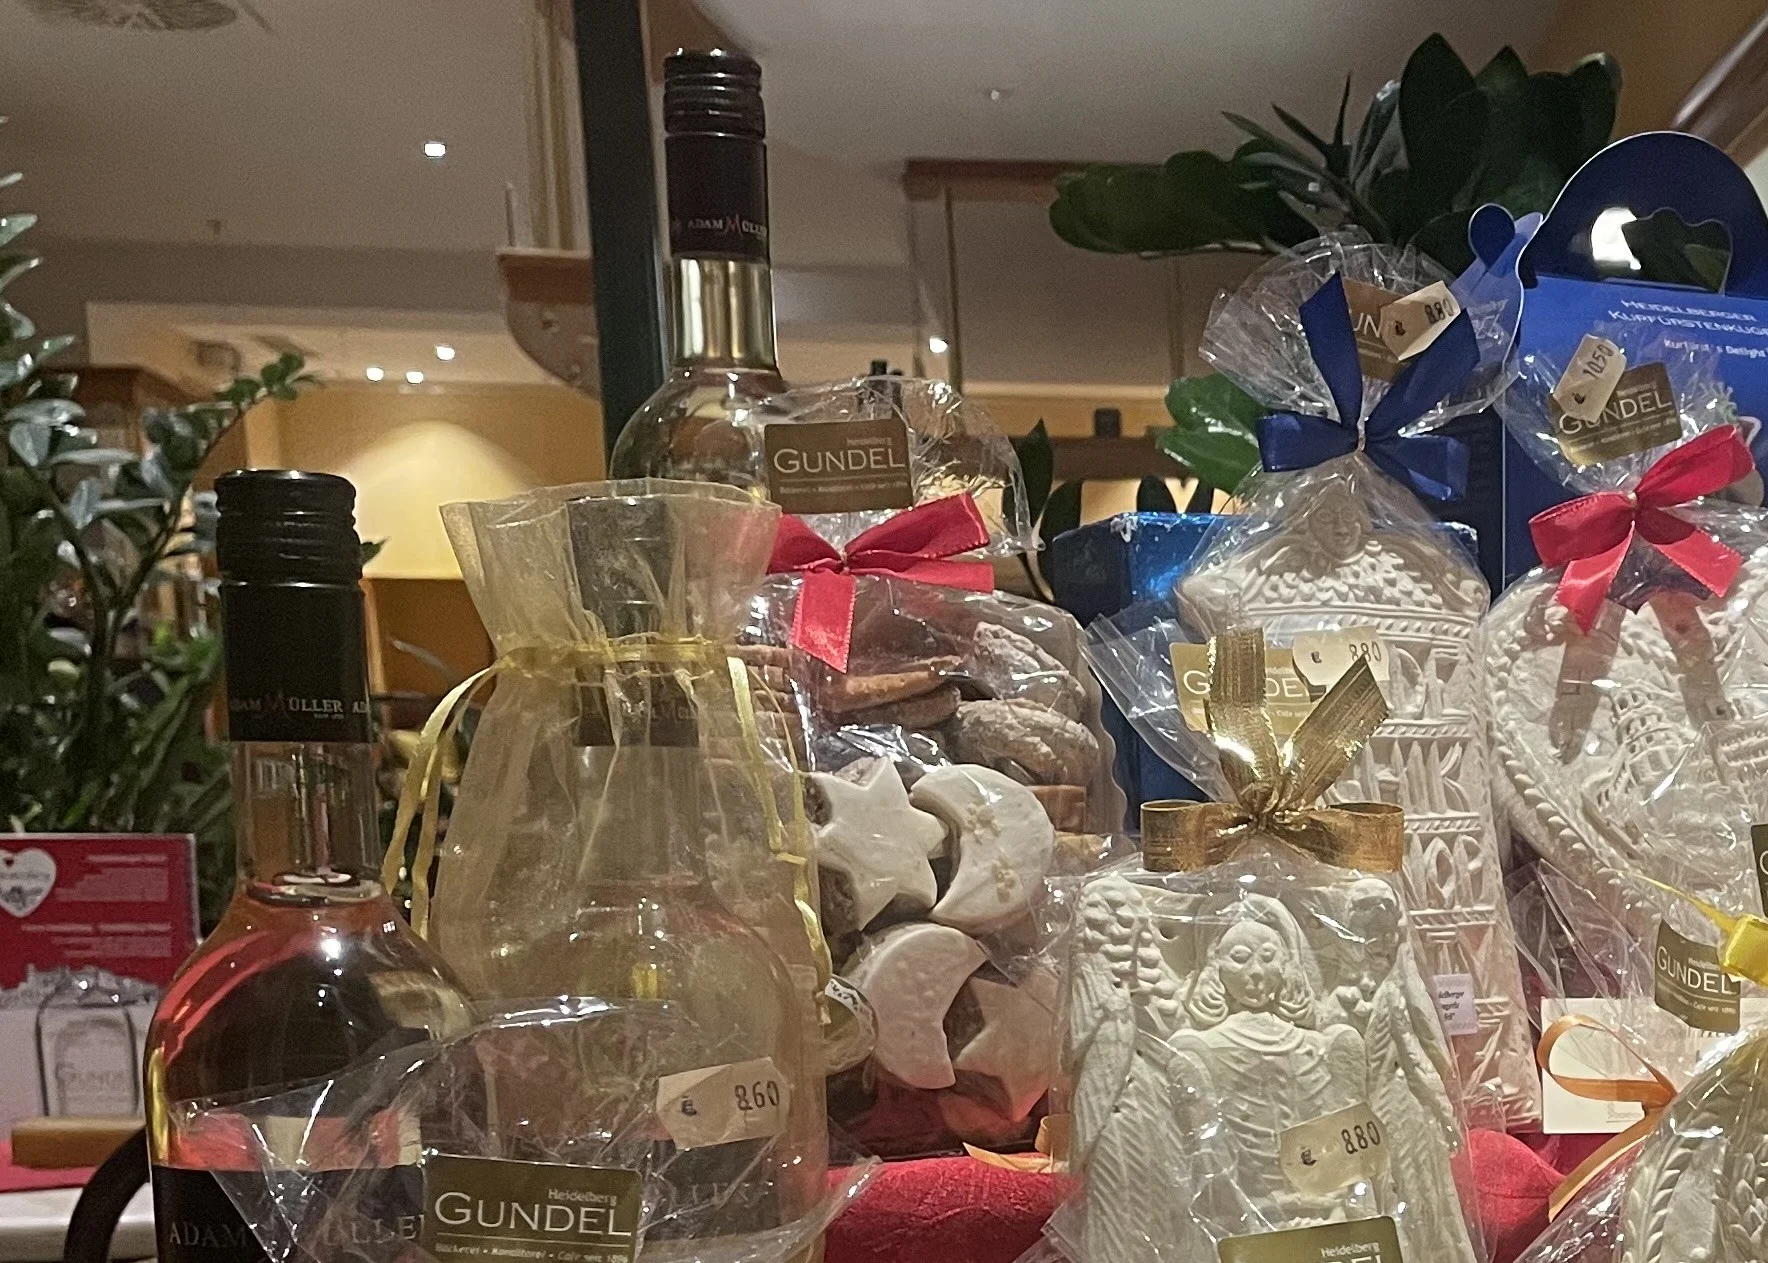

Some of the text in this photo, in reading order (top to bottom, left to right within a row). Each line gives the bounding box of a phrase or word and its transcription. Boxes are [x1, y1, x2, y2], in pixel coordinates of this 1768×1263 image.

[773, 447, 906, 474] GUNDEL
[1656, 945, 1740, 996] GUNDEL
[548, 1188, 618, 1207] Heidelberg
[434, 1191, 632, 1237] GUNDEL
[1320, 1241, 1381, 1259] Heidelberg
